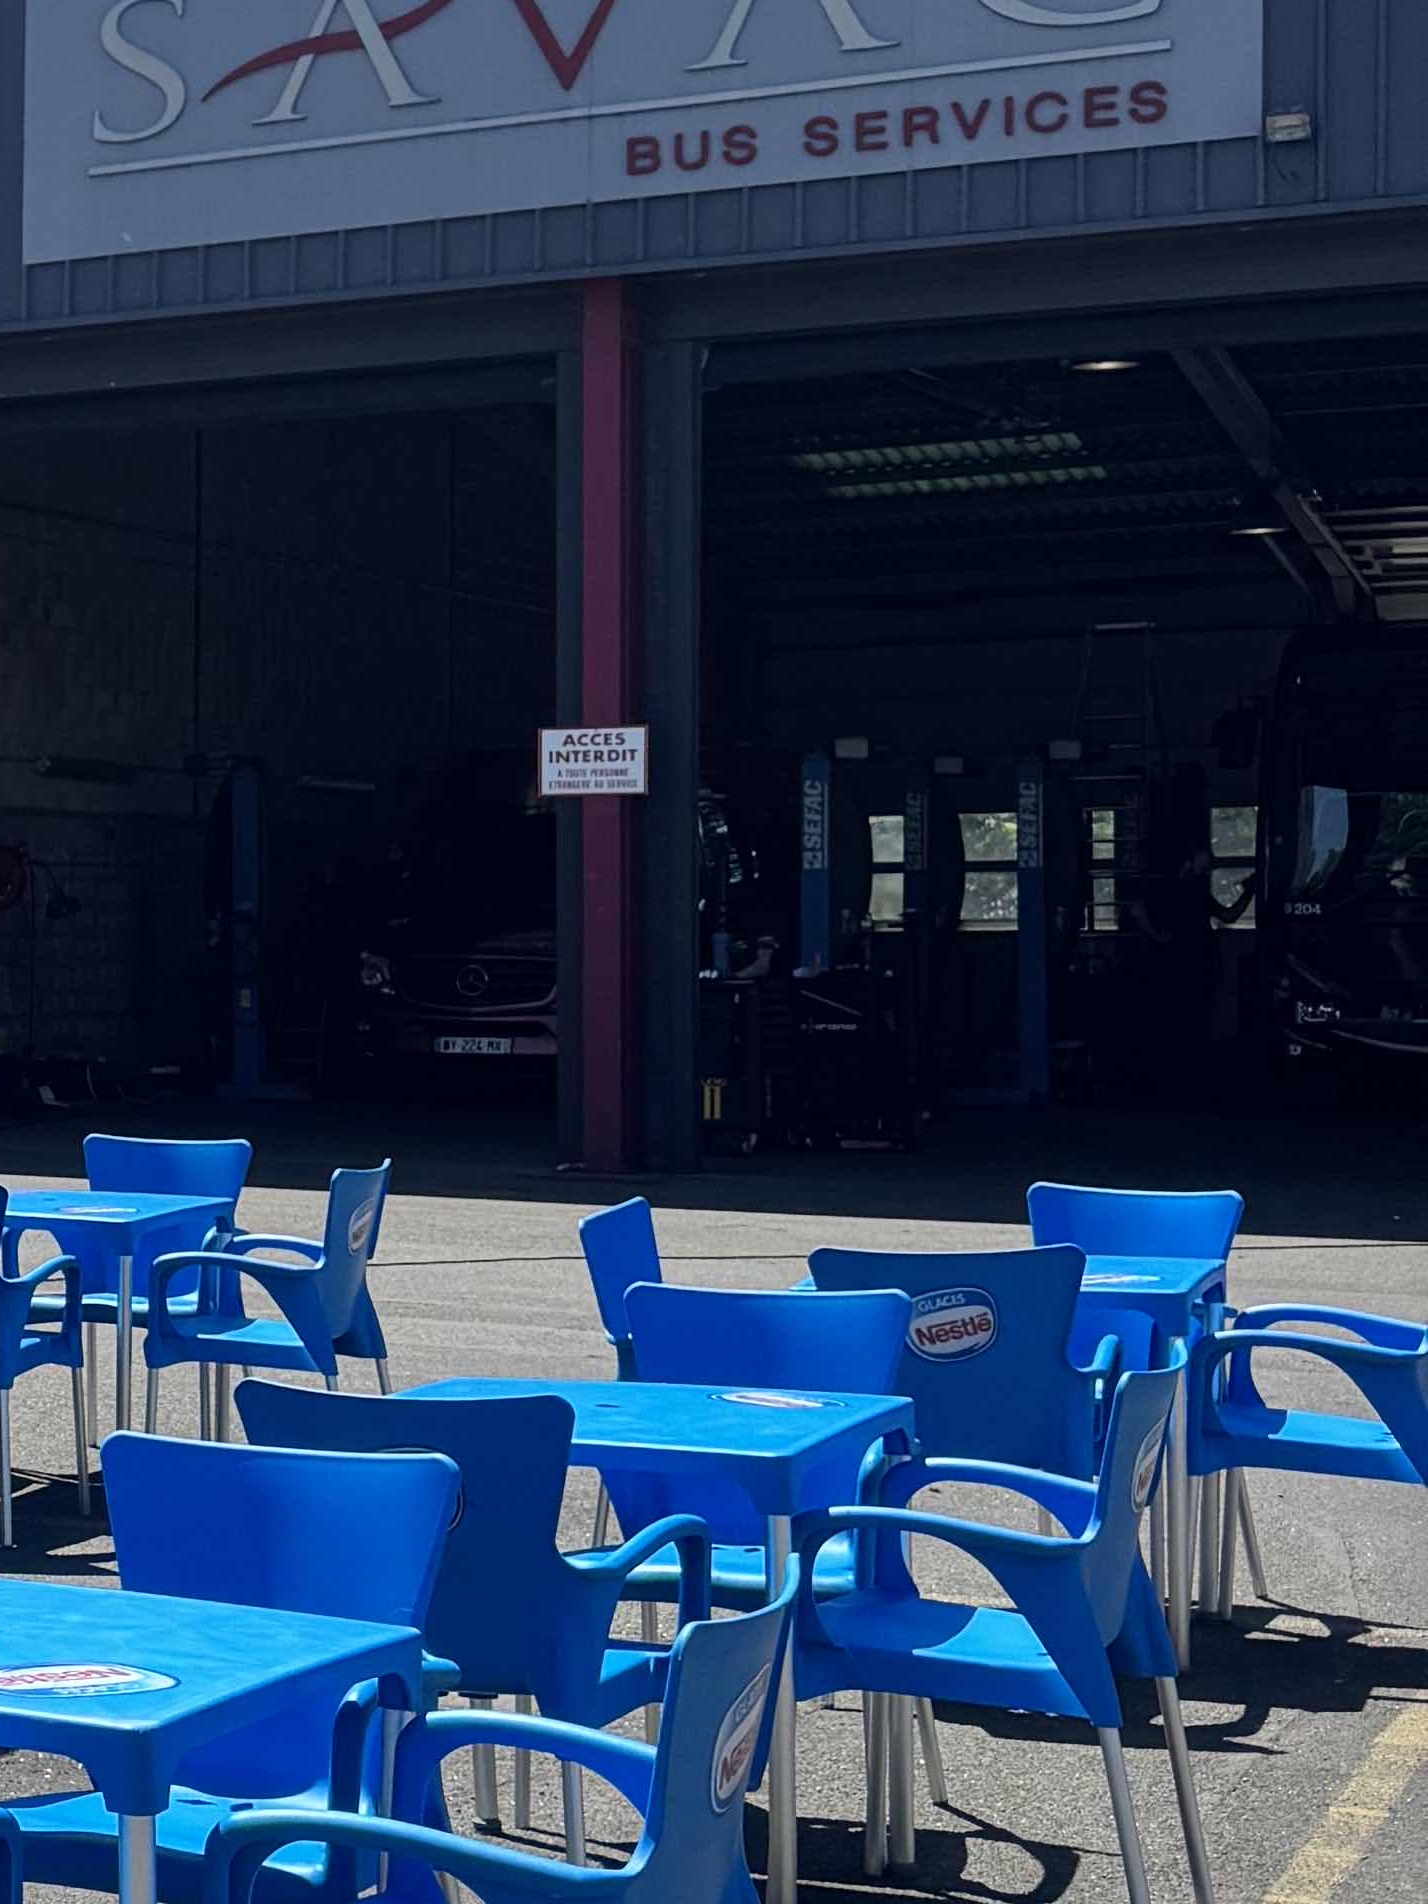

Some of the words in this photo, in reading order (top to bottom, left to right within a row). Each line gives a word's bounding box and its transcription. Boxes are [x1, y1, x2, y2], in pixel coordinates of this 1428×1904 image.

[625, 125, 758, 177] BUS
[803, 79, 1168, 157] SERVICES
[562, 732, 626, 746] ACCES
[548, 749, 638, 763] INTERDIT
[803, 779, 824, 850] SEFAC
[917, 1294, 966, 1312] GLACES
[915, 1312, 992, 1346] Nestlé
